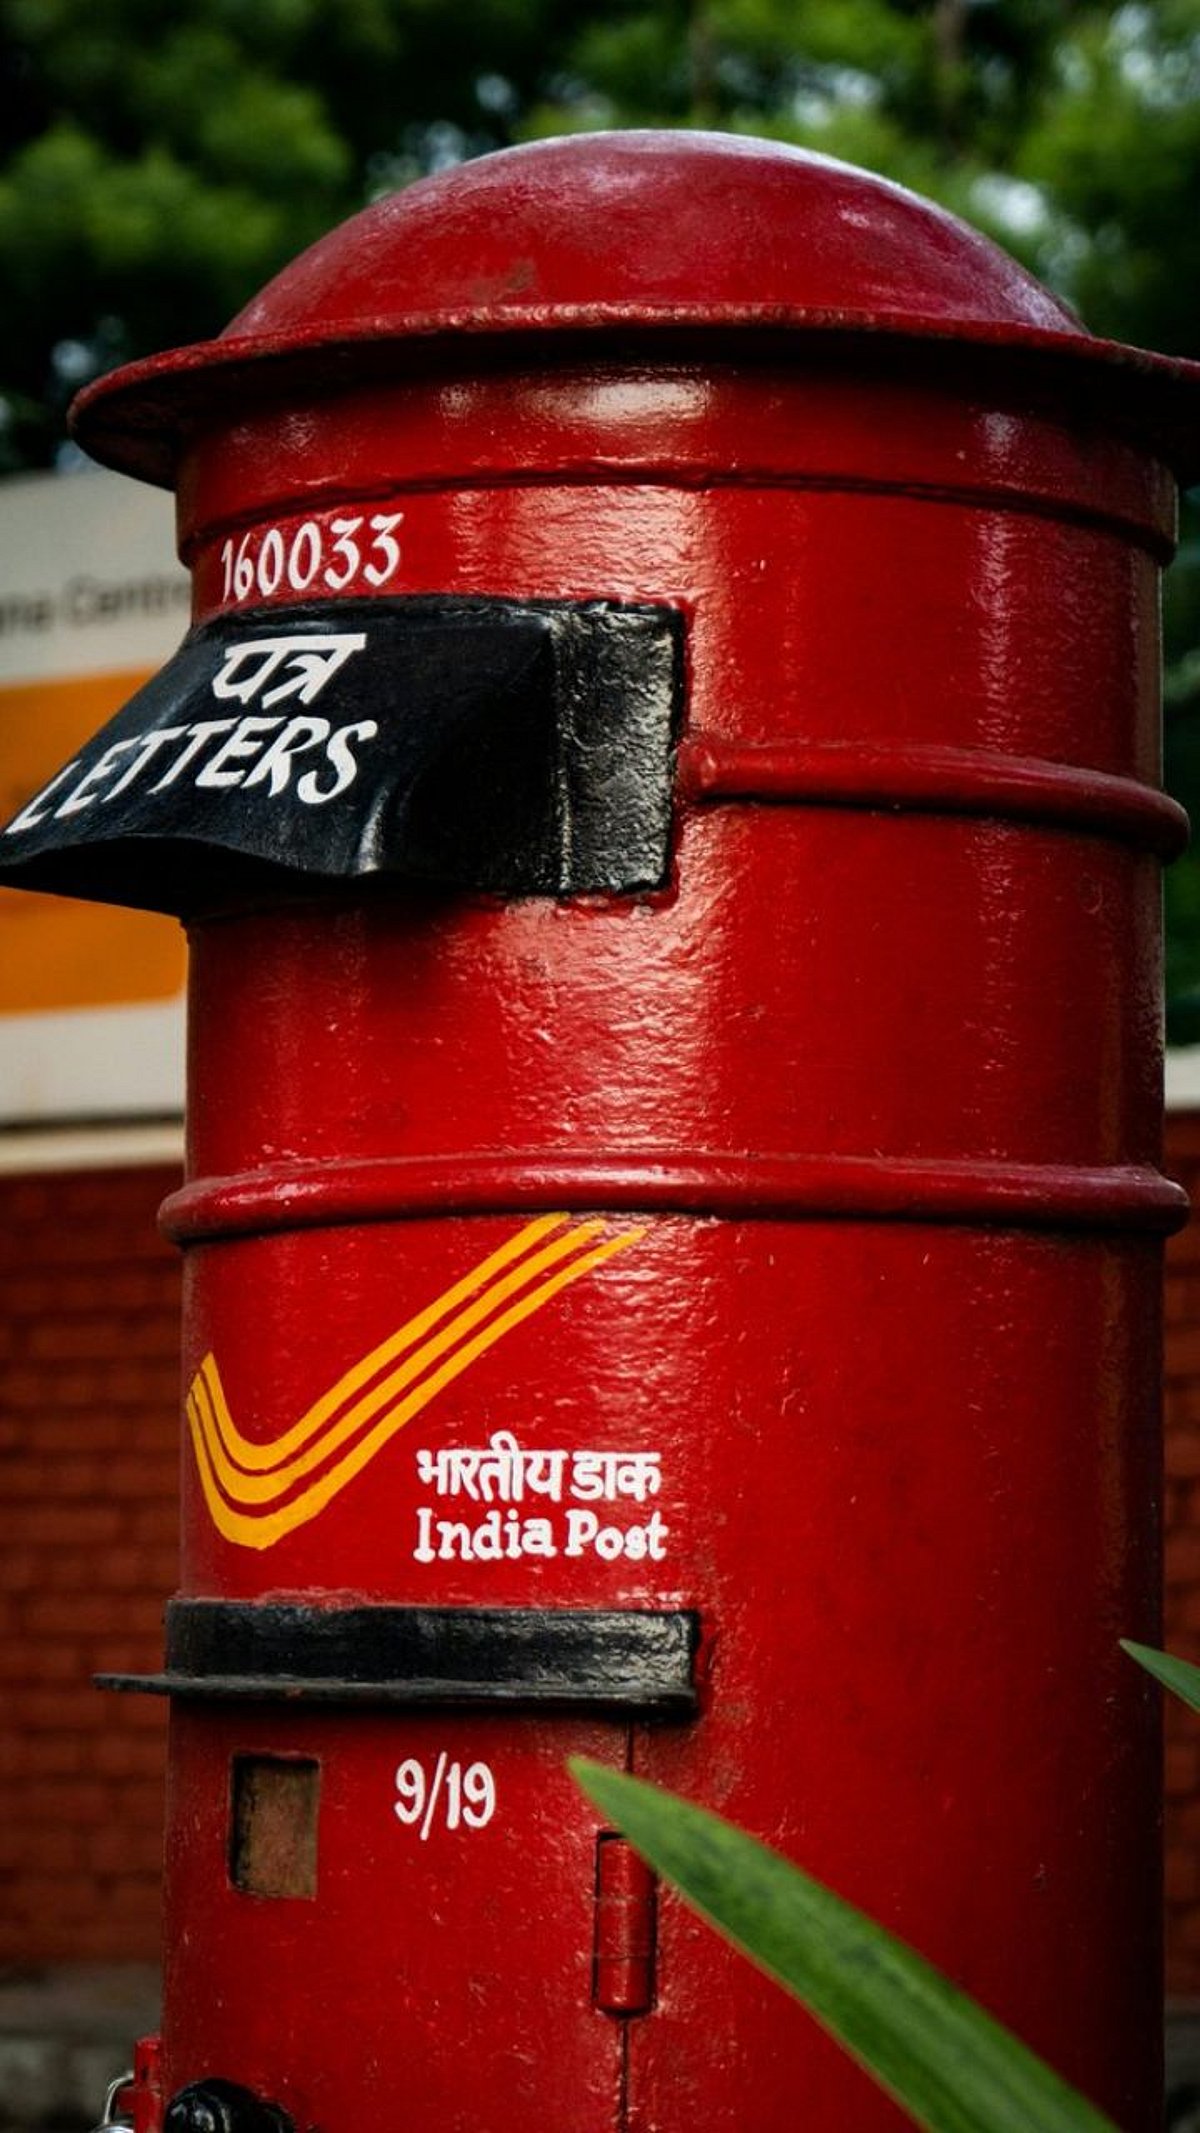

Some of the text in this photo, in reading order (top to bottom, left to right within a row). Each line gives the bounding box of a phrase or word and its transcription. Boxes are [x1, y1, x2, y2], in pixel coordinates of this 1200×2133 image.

[221, 513, 403, 601] 160033
[212, 632, 367, 709] पत्र
[5, 716, 378, 834] LETTERS
[416, 1430, 663, 1502] भारतीय डाक
[413, 1507, 669, 1563] India Post
[394, 1752, 496, 1841] 9/19
